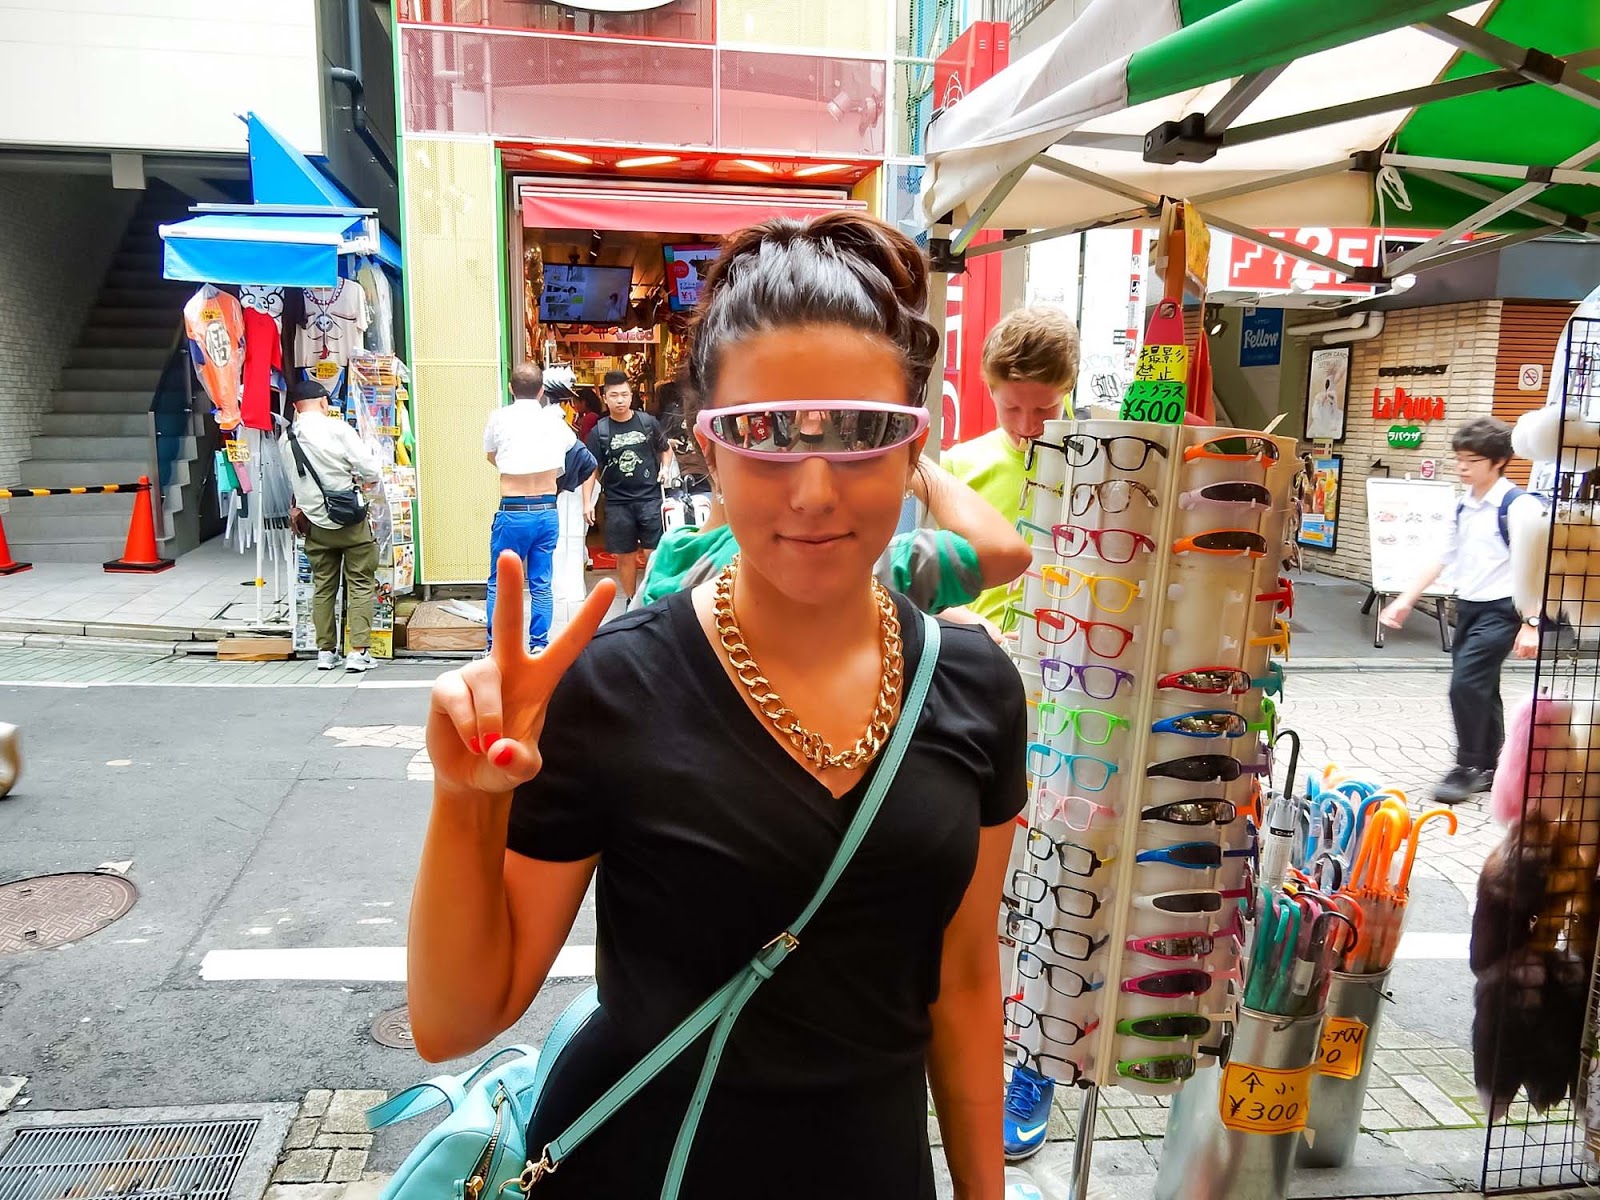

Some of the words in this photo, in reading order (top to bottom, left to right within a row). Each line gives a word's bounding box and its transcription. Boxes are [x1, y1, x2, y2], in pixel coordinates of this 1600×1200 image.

[1291, 227, 1368, 285] 2F
[1136, 363, 1175, 381] 禁止
[1122, 398, 1181, 423] ¥500
[1228, 1095, 1298, 1121] ¥300
